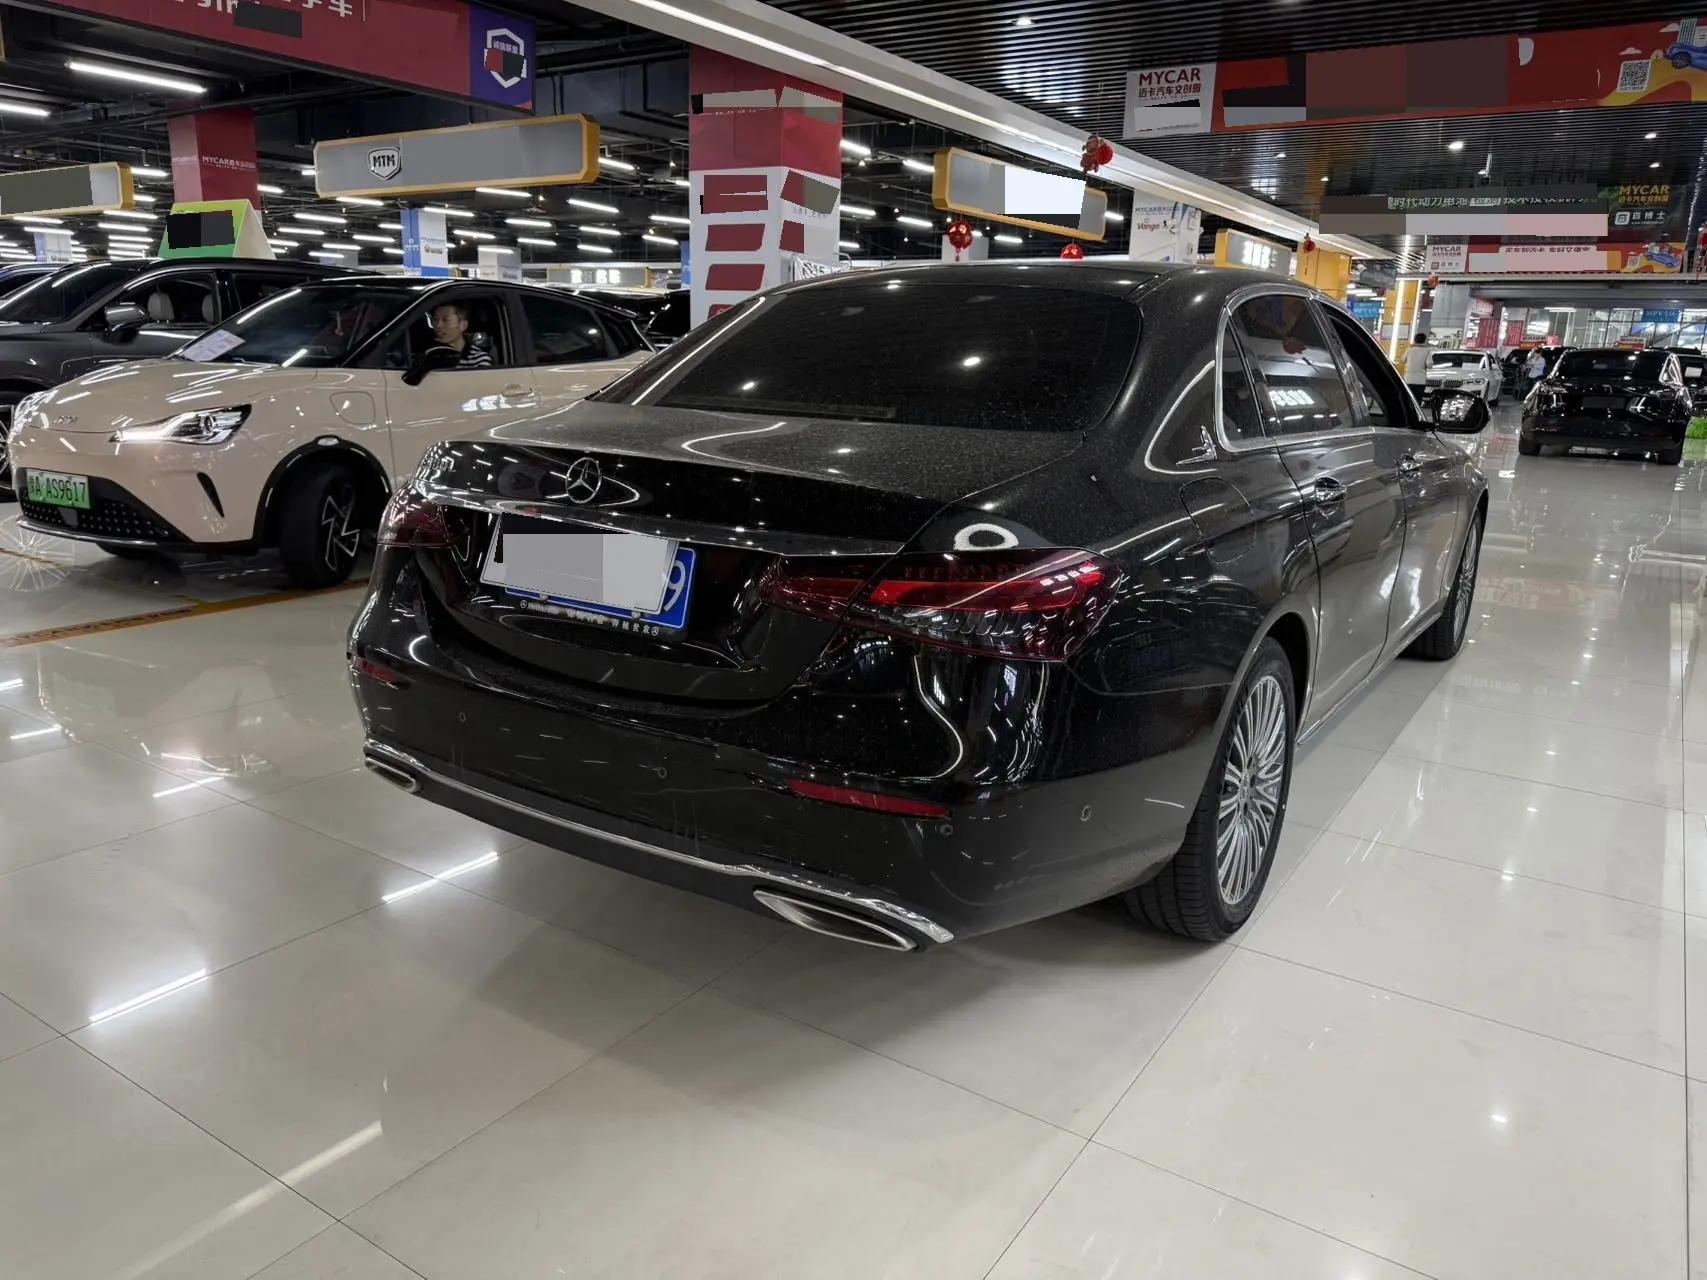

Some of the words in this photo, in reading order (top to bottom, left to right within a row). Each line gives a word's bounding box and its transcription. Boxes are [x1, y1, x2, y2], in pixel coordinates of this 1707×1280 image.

[1139, 68, 1201, 86] MYCAR
[373, 154, 395, 167] MTM
[1619, 184, 1671, 195] MYCAR
